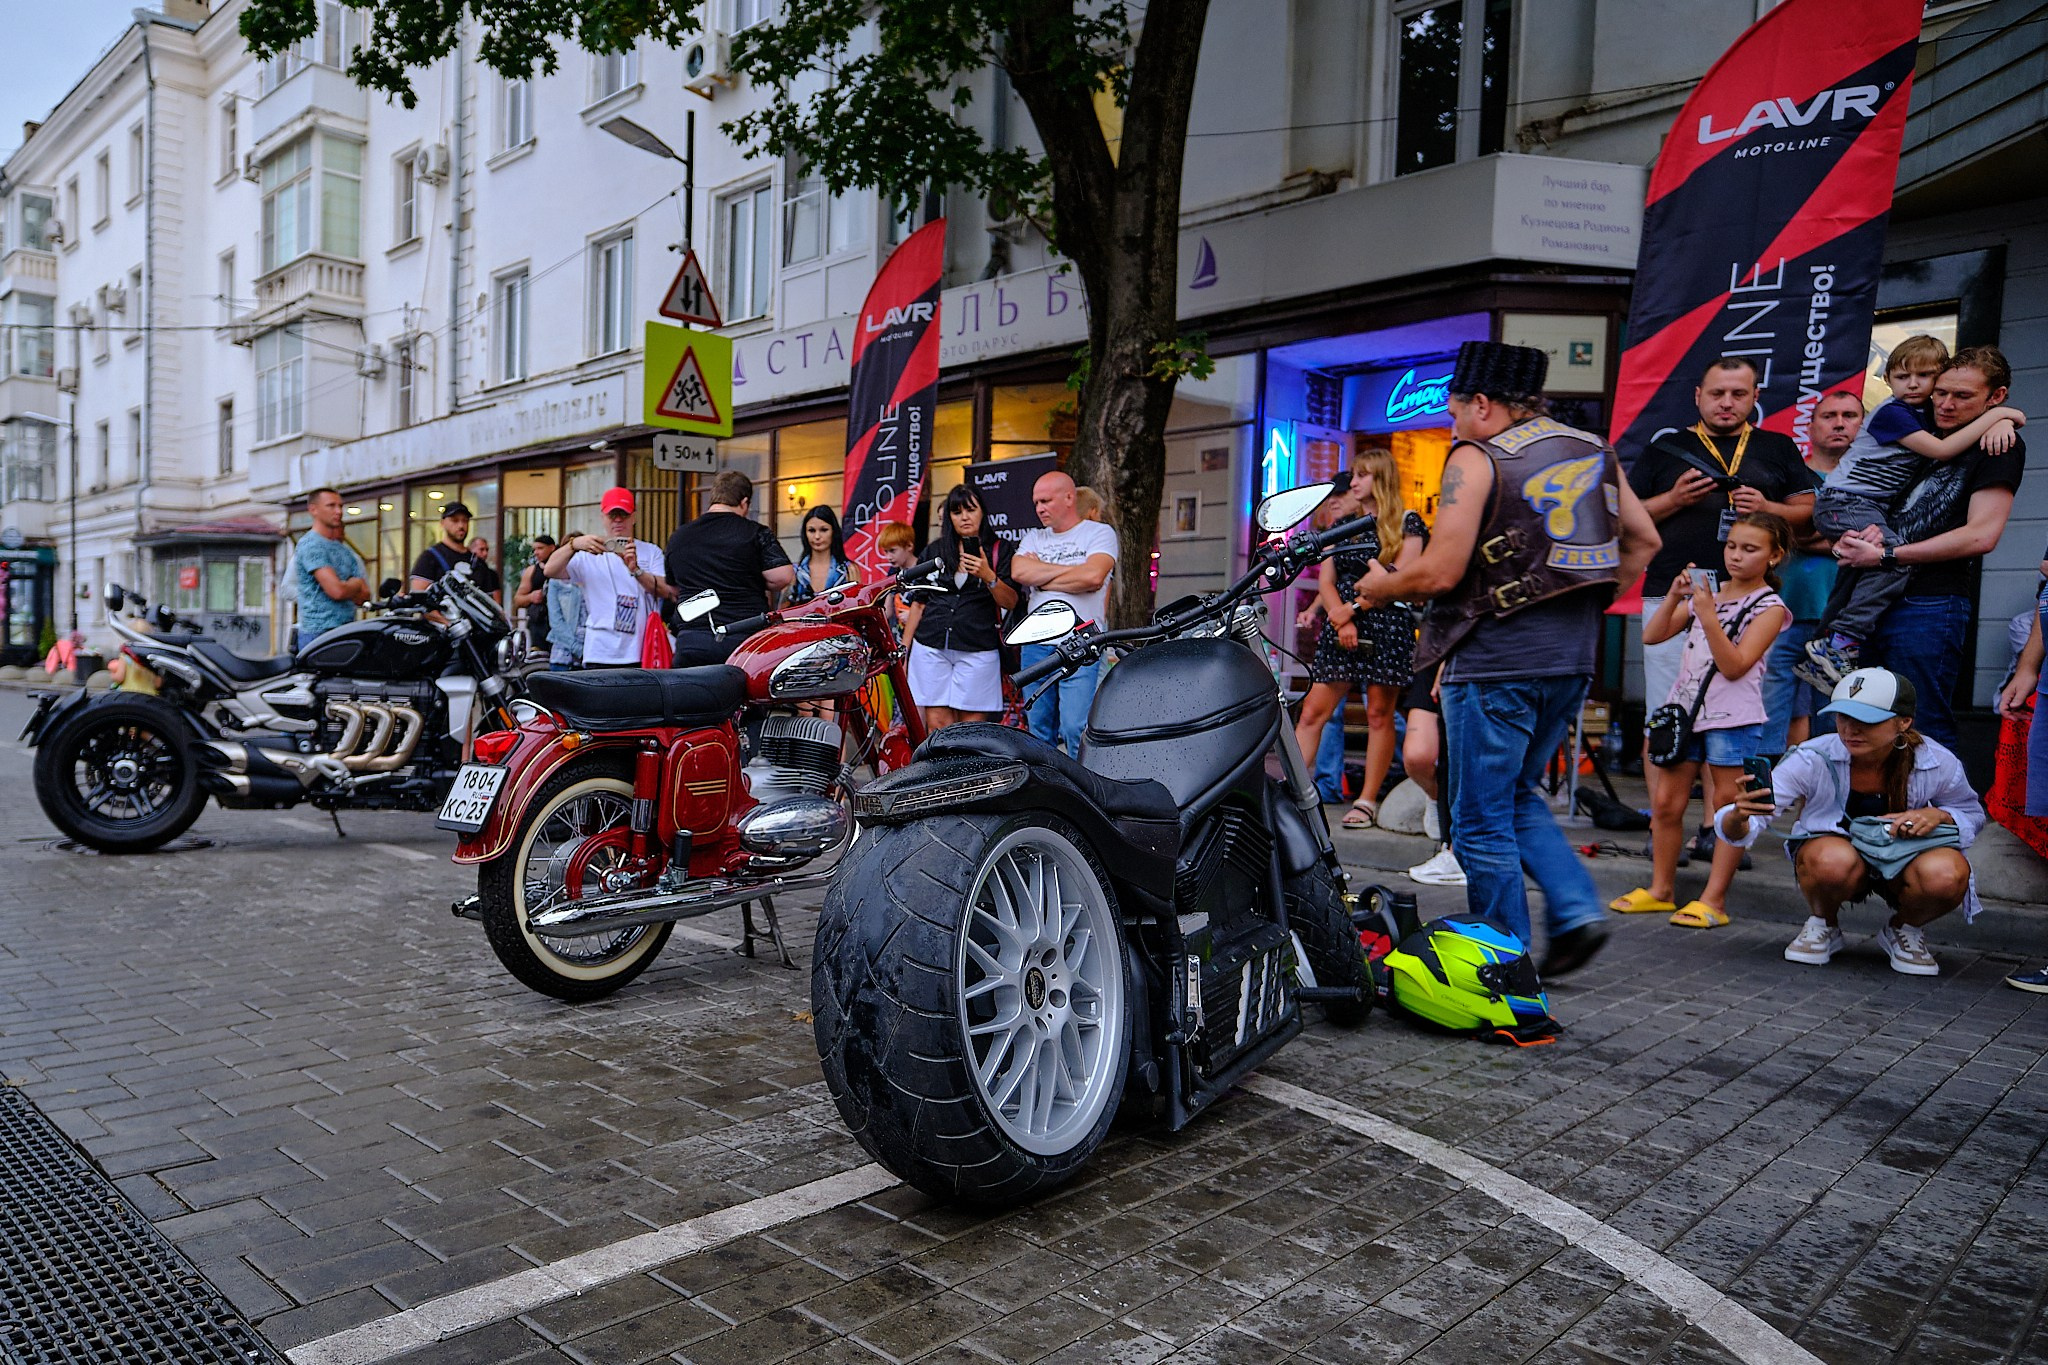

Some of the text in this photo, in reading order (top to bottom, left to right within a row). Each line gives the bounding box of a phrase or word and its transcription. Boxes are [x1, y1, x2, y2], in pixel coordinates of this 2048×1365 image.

[1734, 136, 1831, 159] MOTOLINE
[1541, 175, 1588, 191] Лучший
[1544, 199, 1606, 213] по мнению
[1520, 214, 1631, 234] Кузнецова Родиона
[1541, 236, 1609, 253] Романовича
[972, 333, 1019, 353] ПАРУС
[974, 472, 1009, 485] LAVR
[393, 632, 430, 644] TRIUMPH
[463, 769, 498, 792] 1804
[471, 791, 483, 800] RUS
[465, 801, 487, 820] 23
